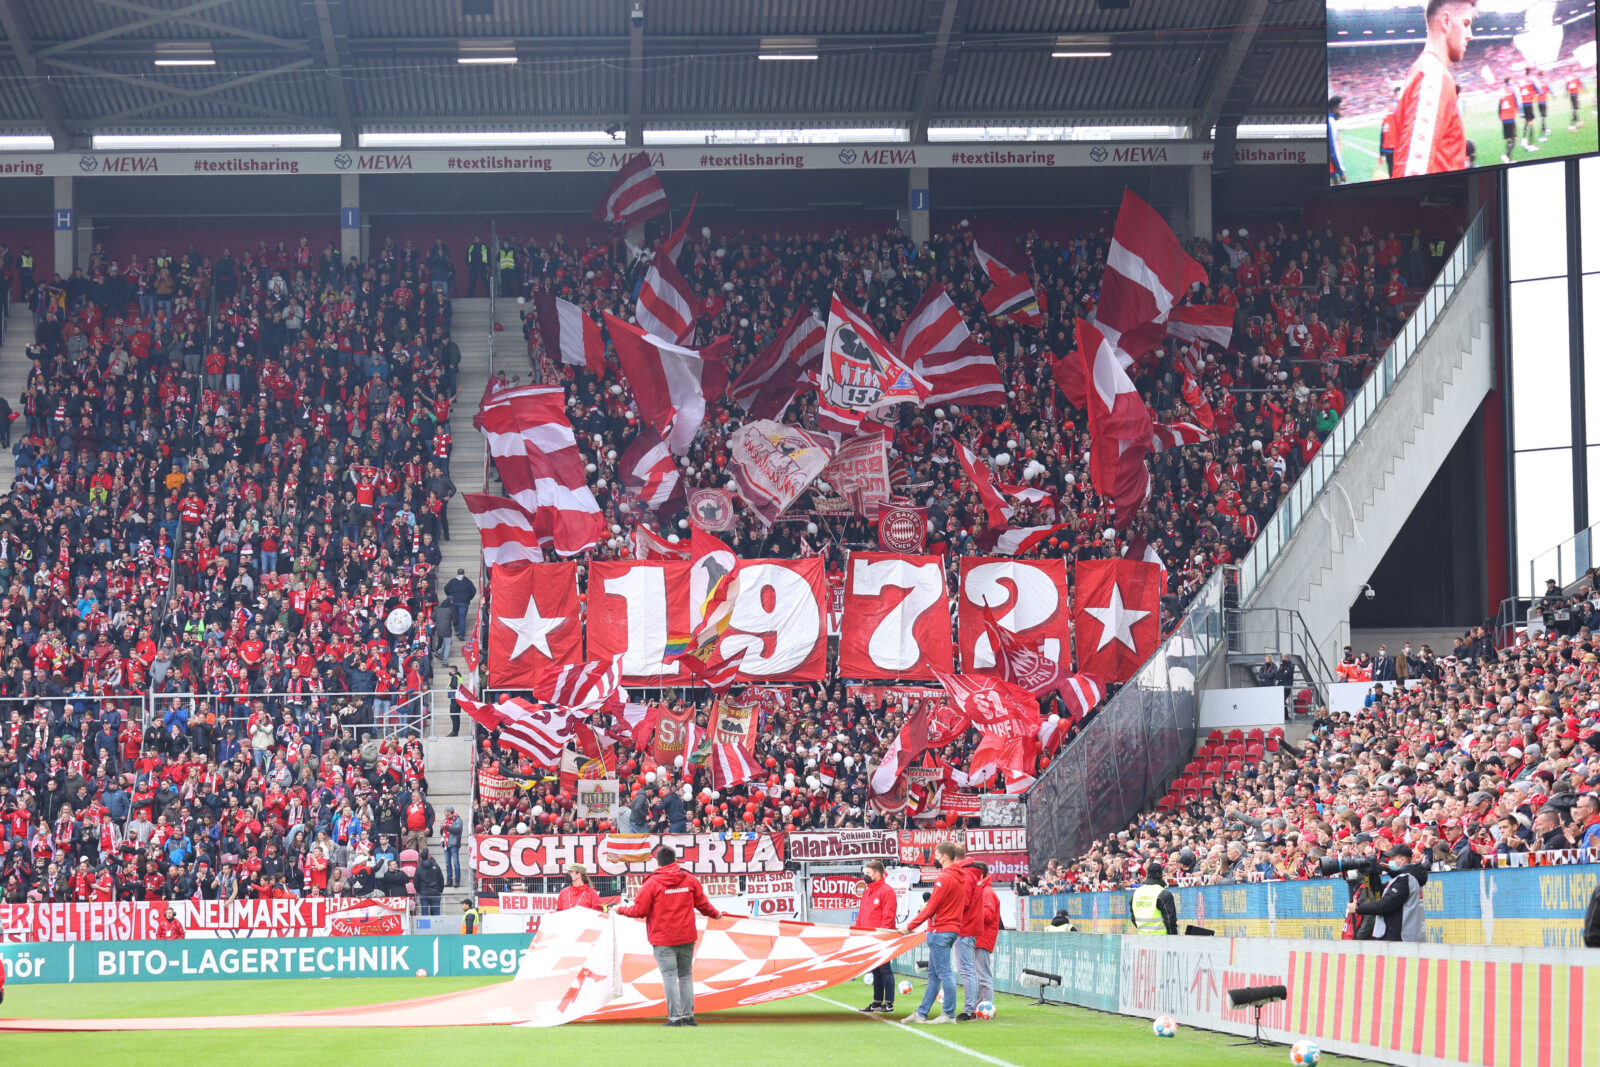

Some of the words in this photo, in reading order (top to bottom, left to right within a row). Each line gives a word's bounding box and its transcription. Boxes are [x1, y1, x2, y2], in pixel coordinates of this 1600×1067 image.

[357, 154, 413, 170] MEWA
[700, 152, 804, 168] #textilsharing
[861, 150, 917, 165] MEWA
[951, 150, 1056, 166] #textilsharing
[1112, 147, 1168, 162] MEWA
[102, 156, 159, 173] MEWA
[193, 158, 300, 174] #textilsharing
[447, 155, 553, 172] #textilsharing
[917, 192, 924, 209] J
[57, 212, 71, 227] H
[1017, 667, 1052, 690] CHEN
[966, 829, 1027, 852] COLEGIO
[901, 846, 920, 862] RED
[769, 871, 795, 882] SIND
[707, 884, 737, 896] UNS
[746, 883, 770, 895] BEI
[771, 881, 795, 893] DIR
[813, 877, 861, 895] SÜDTIR
[502, 895, 528, 910] RED
[184, 897, 326, 929] NEUMARKT
[98, 945, 410, 976] BITO-LAGERTECHNIK
